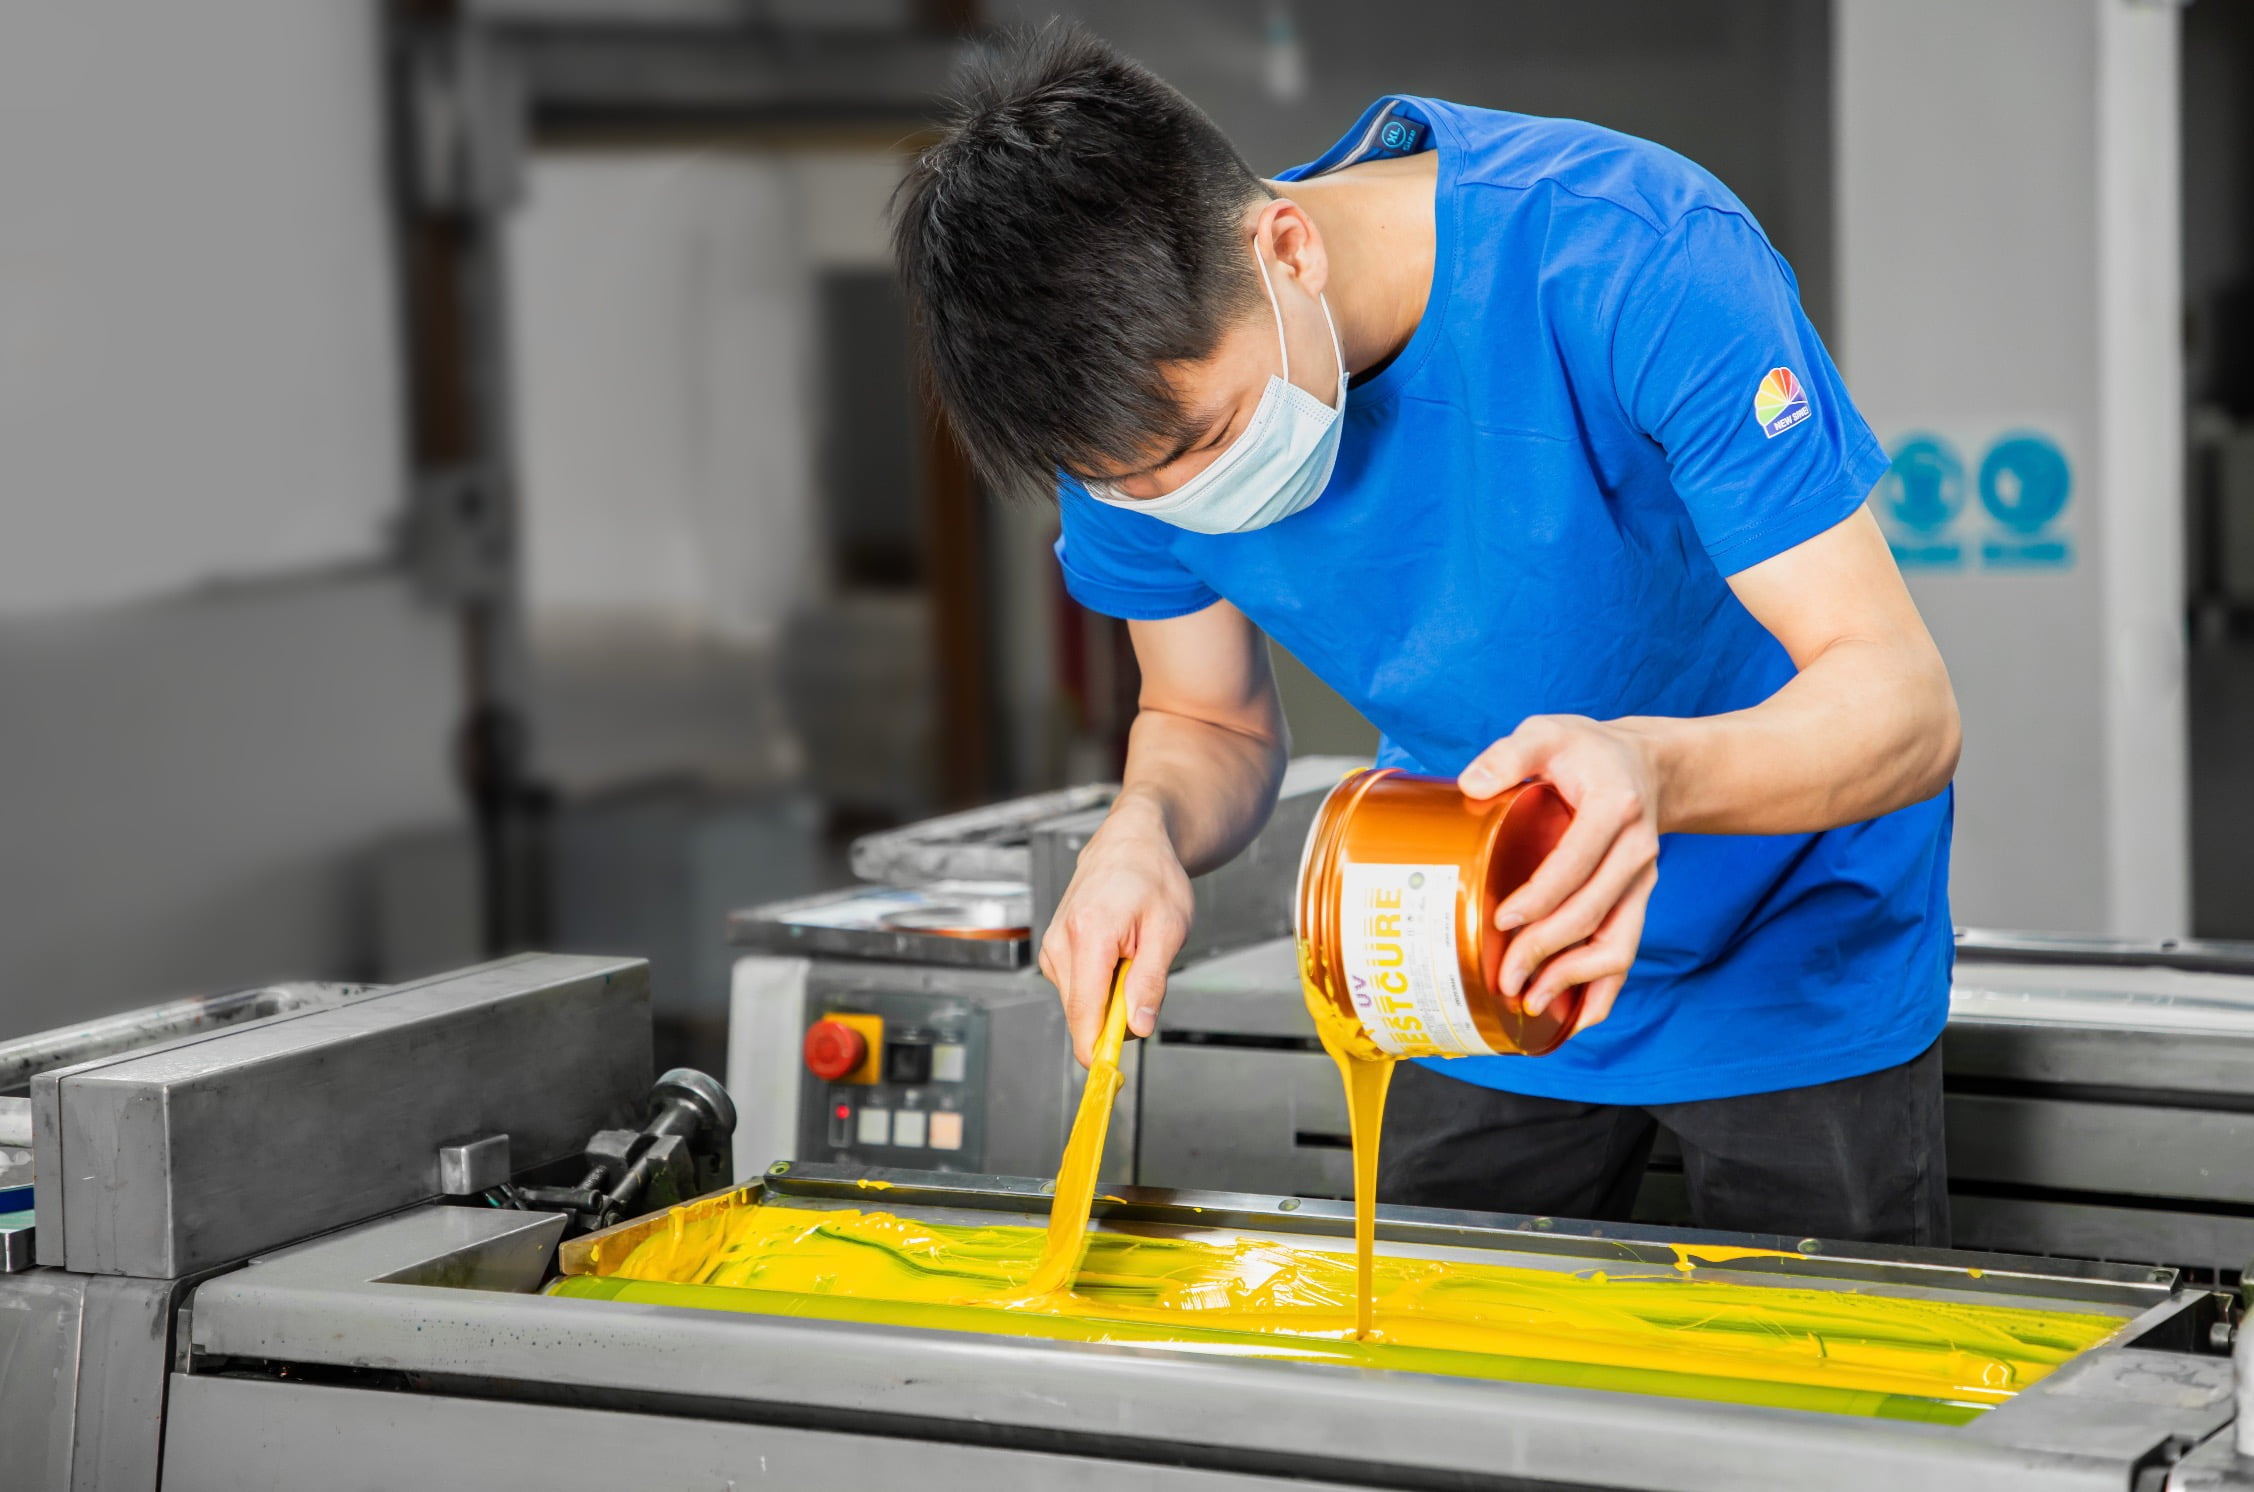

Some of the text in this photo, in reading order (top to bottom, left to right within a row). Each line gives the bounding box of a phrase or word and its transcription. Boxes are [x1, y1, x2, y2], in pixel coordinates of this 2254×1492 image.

[1387, 127, 1401, 144] XL
[1773, 415, 1793, 431] NEW
[1366, 887, 1437, 1055] ESTCURE
[1352, 975, 1373, 1008] UV
